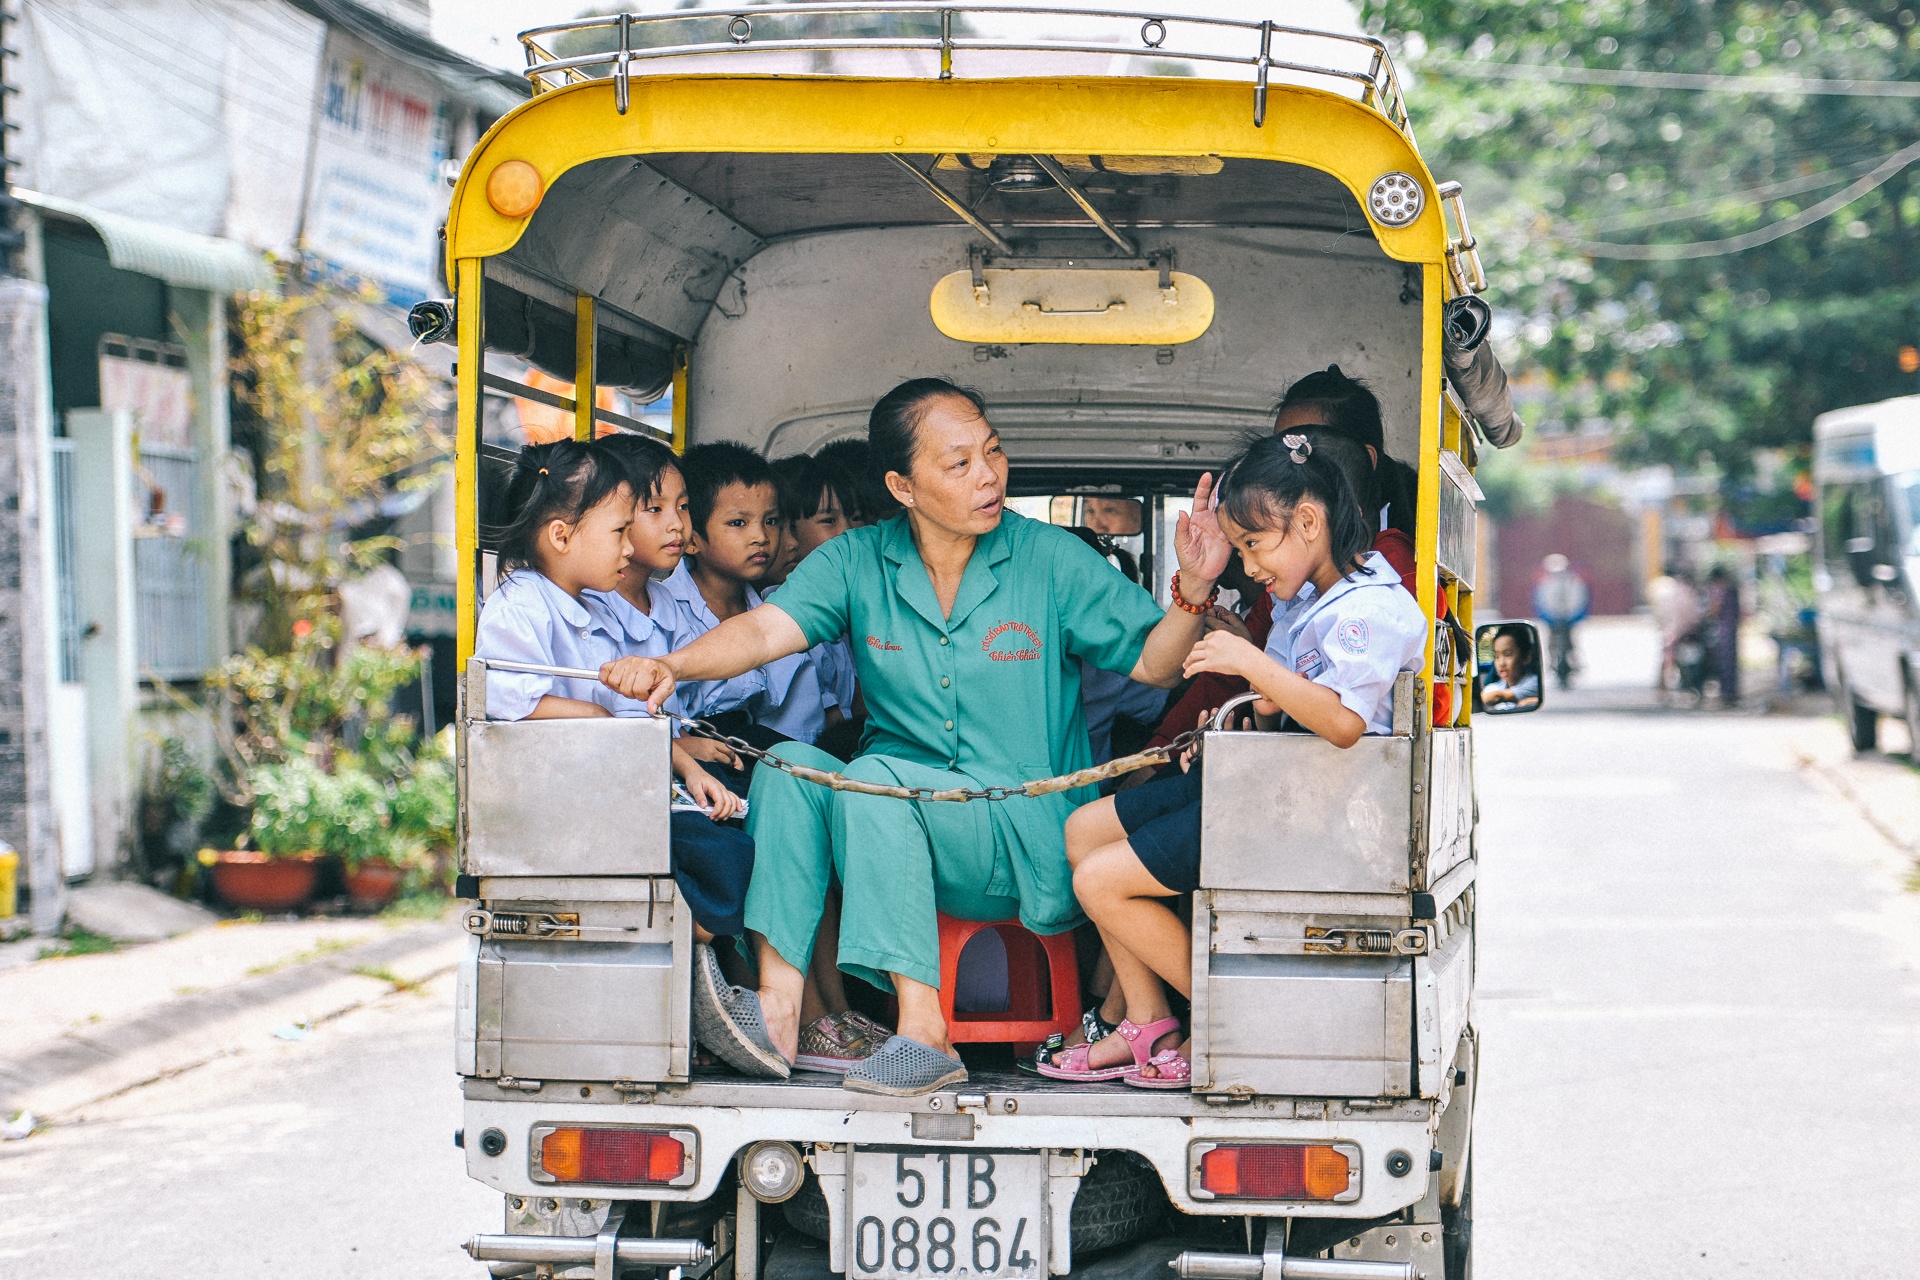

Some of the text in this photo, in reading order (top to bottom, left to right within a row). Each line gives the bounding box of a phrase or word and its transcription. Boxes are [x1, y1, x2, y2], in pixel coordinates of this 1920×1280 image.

[1032, 637, 1044, 649] EM
[896, 1153, 997, 1210] 51B
[856, 1216, 1038, 1275] 088.64
